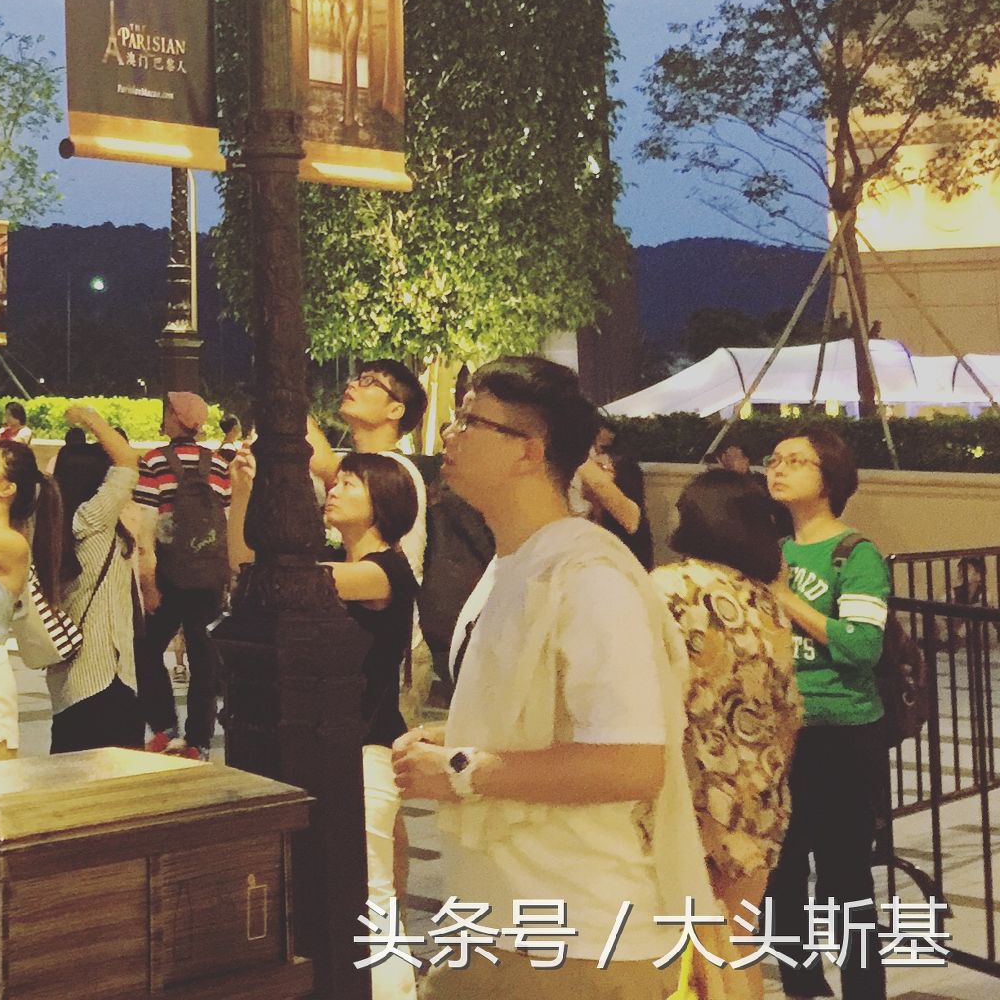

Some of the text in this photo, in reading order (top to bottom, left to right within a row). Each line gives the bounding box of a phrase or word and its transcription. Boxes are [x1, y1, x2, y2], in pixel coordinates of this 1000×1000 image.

[117, 26, 186, 55] PARISIAN
[126, 51, 187, 74] 澳门巴黎人
